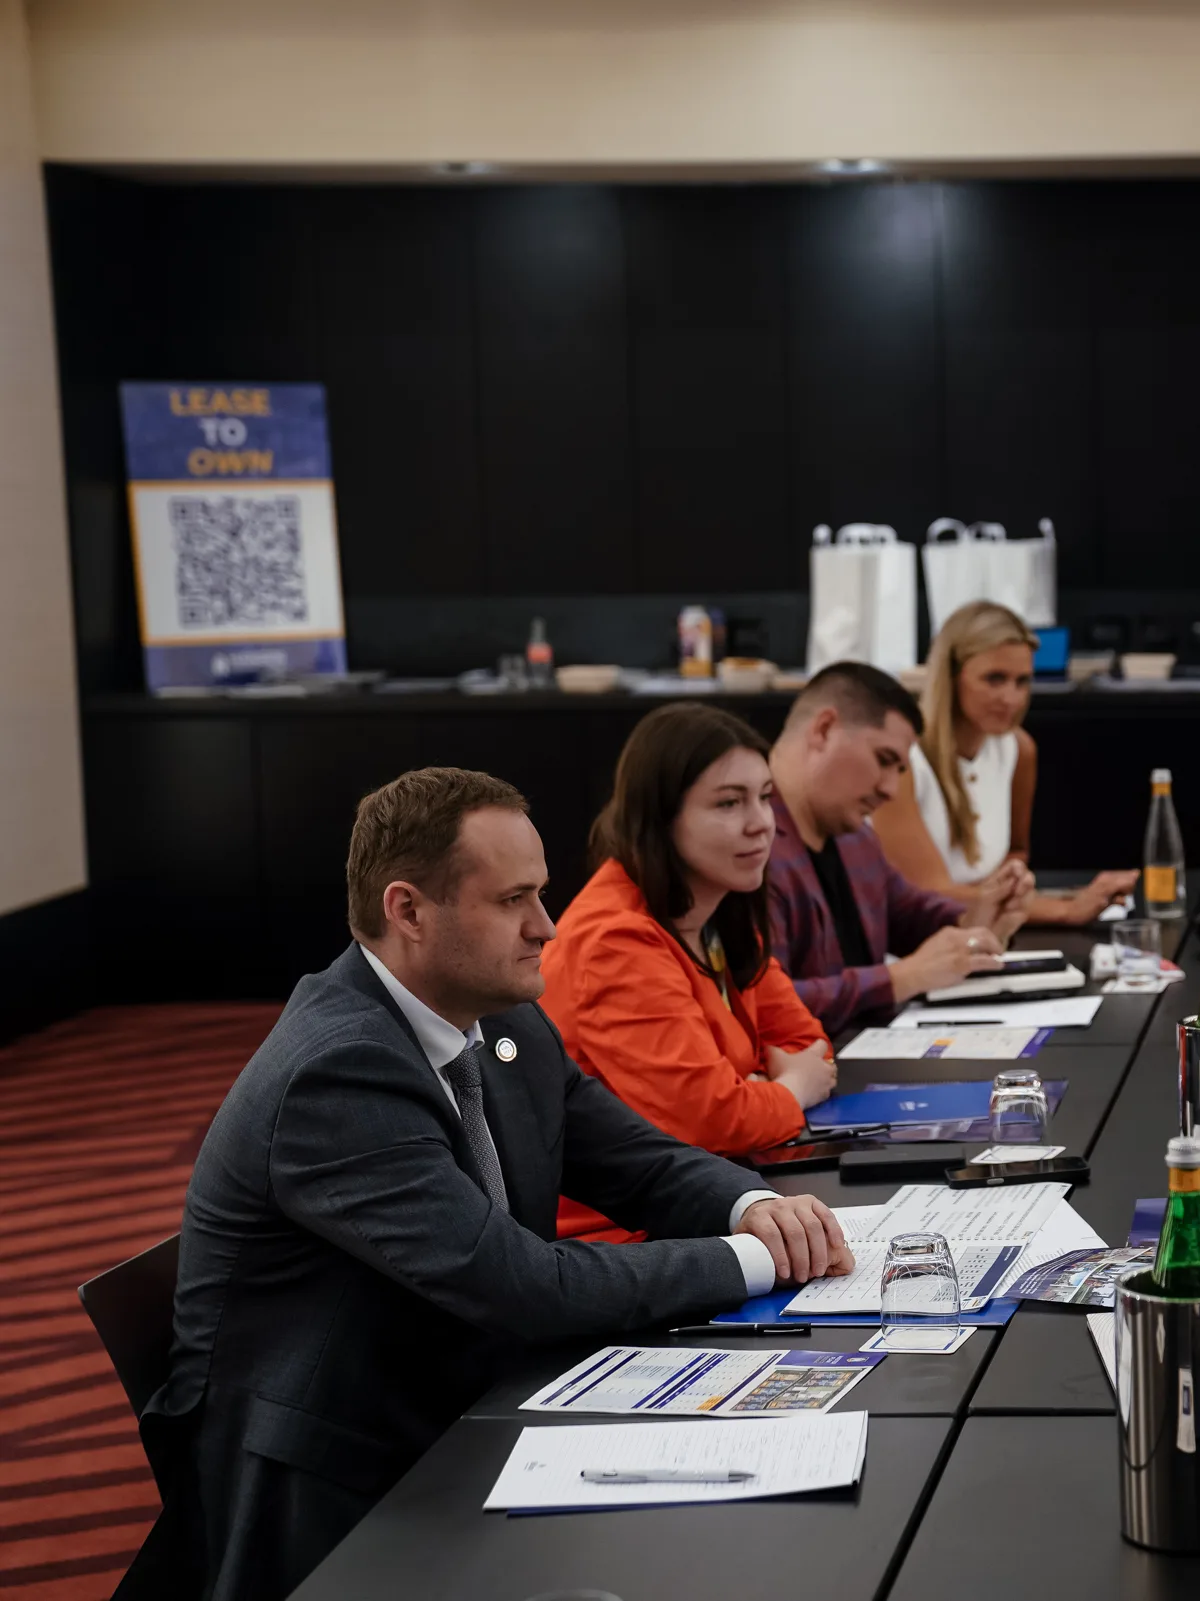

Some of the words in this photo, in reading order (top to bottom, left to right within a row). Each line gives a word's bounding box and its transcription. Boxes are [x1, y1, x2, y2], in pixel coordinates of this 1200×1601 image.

[168, 388, 272, 416] LEASE
[200, 417, 247, 446] TO
[187, 448, 273, 475] OWN
